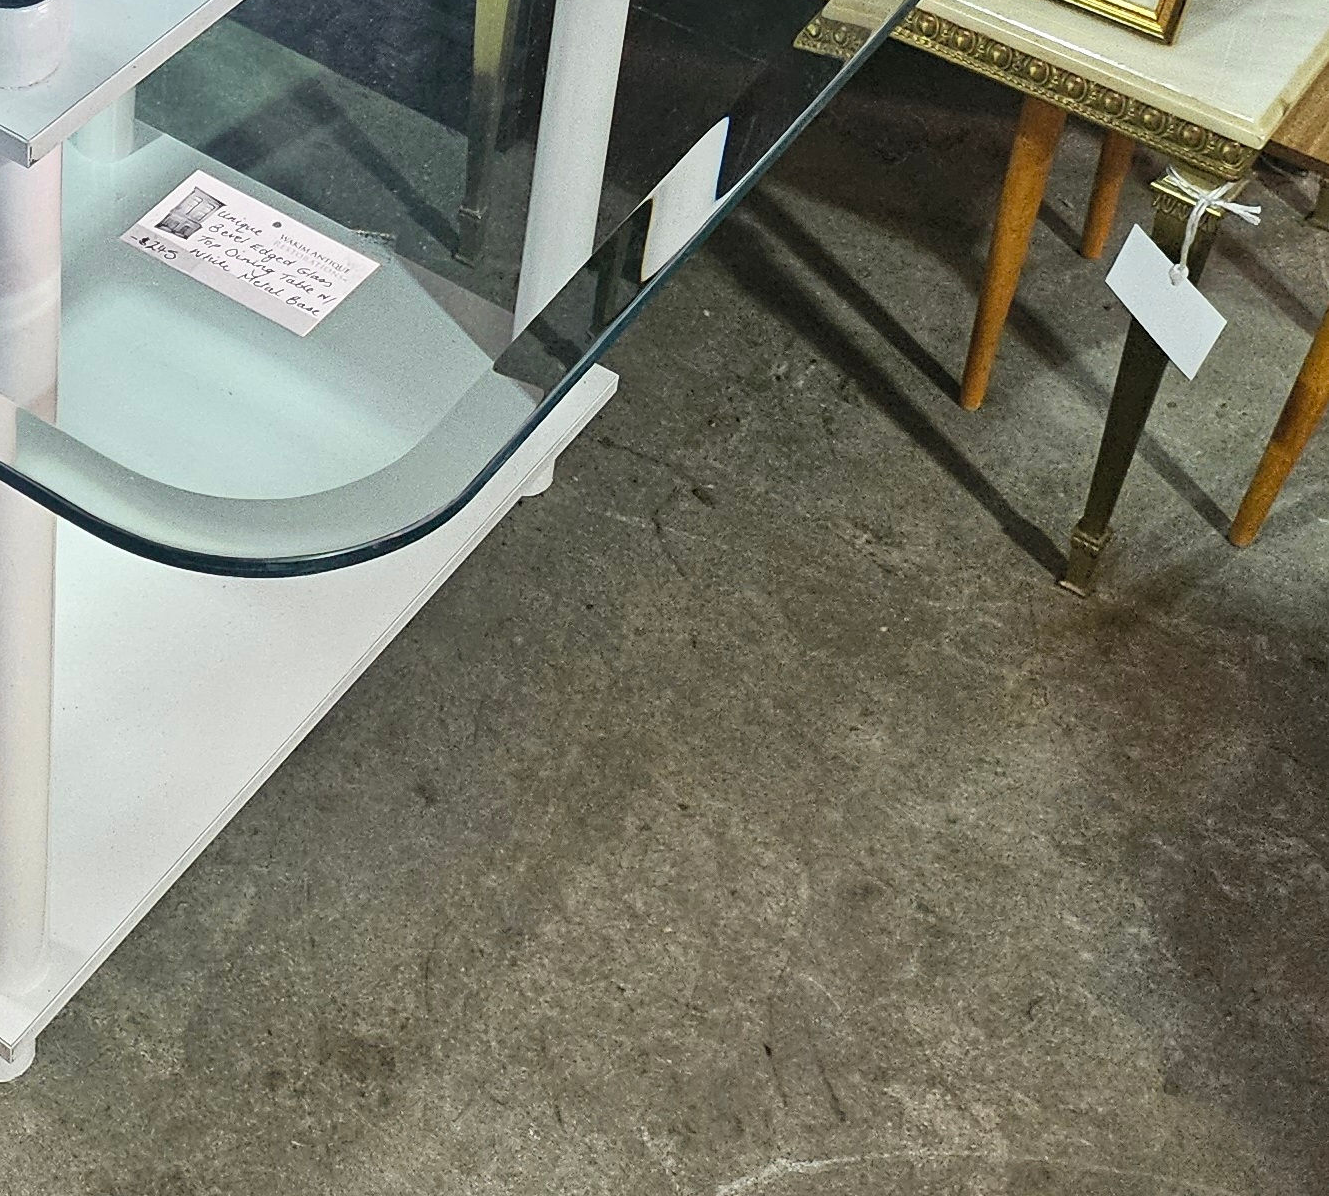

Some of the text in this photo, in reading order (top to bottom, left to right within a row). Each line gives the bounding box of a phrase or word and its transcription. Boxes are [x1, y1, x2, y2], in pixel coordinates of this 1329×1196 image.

[217, 210, 263, 236] Unique
[190, 248, 320, 317] White Metal Base
[197, 235, 222, 249] Top
[225, 248, 276, 278] Dining
[279, 273, 314, 294] Table
[208, 223, 333, 288] Bevel Edged Glass
